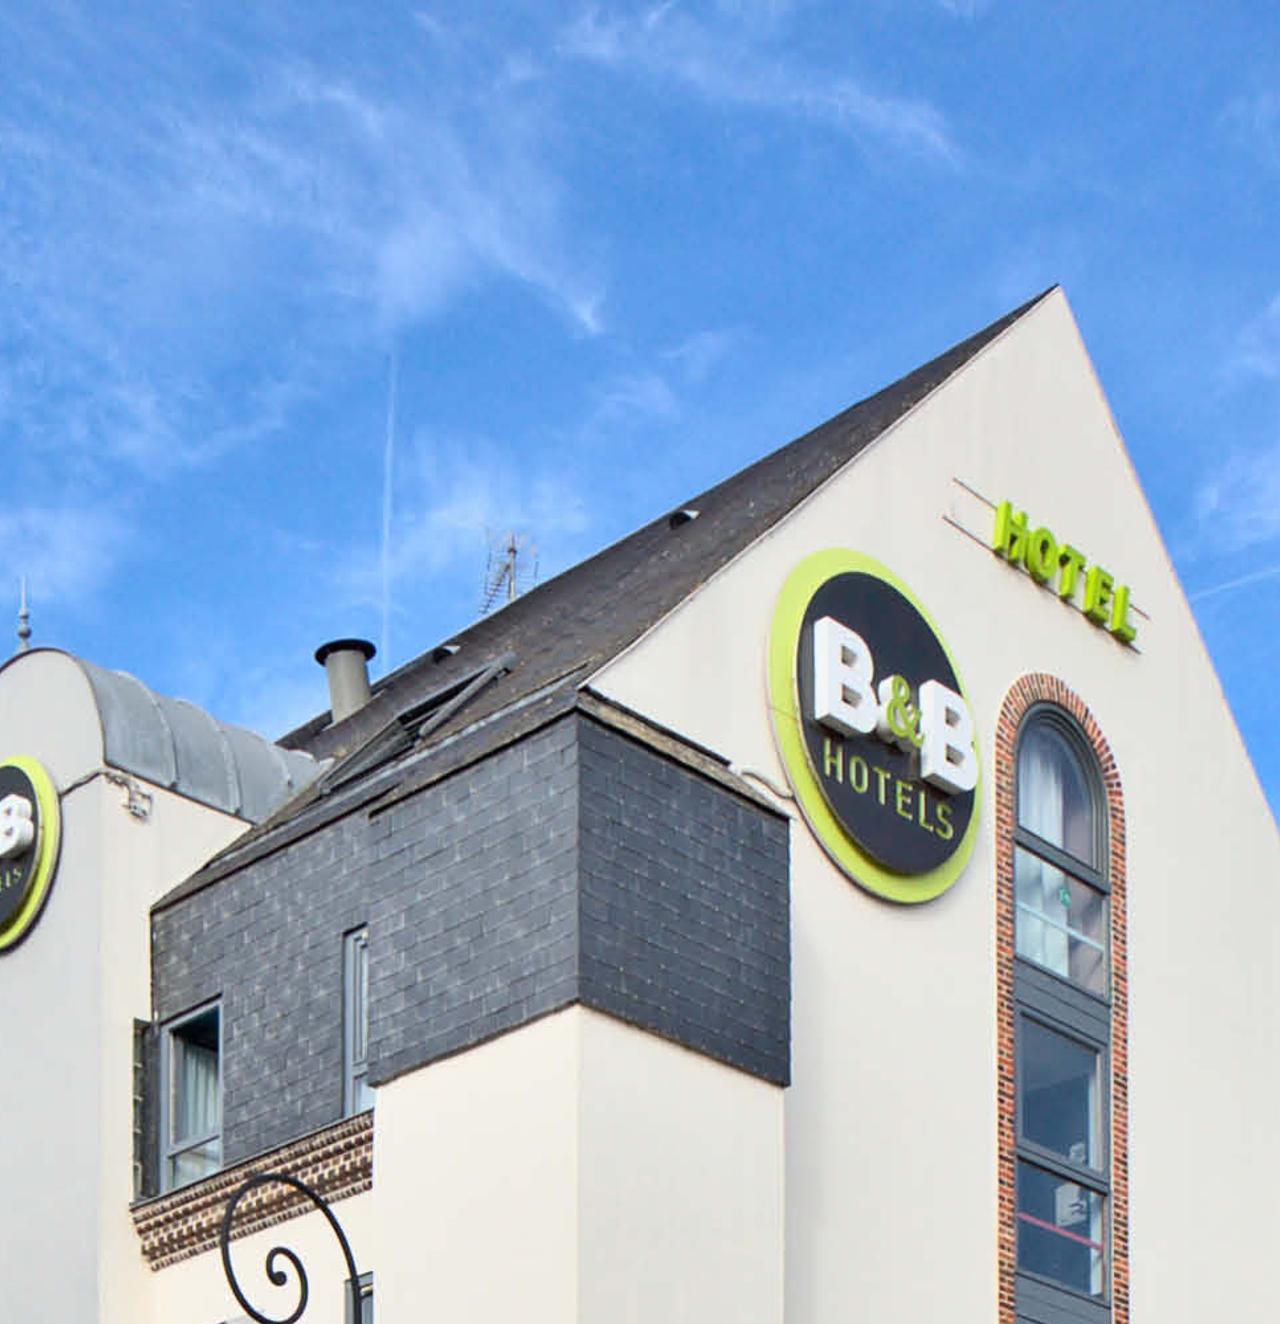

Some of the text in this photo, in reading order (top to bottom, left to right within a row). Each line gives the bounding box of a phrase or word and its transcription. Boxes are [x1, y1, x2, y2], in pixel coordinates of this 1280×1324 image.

[993, 500, 1137, 641] HOTEL
[814, 615, 978, 793] B&B
[823, 737, 954, 840] HOTELS
